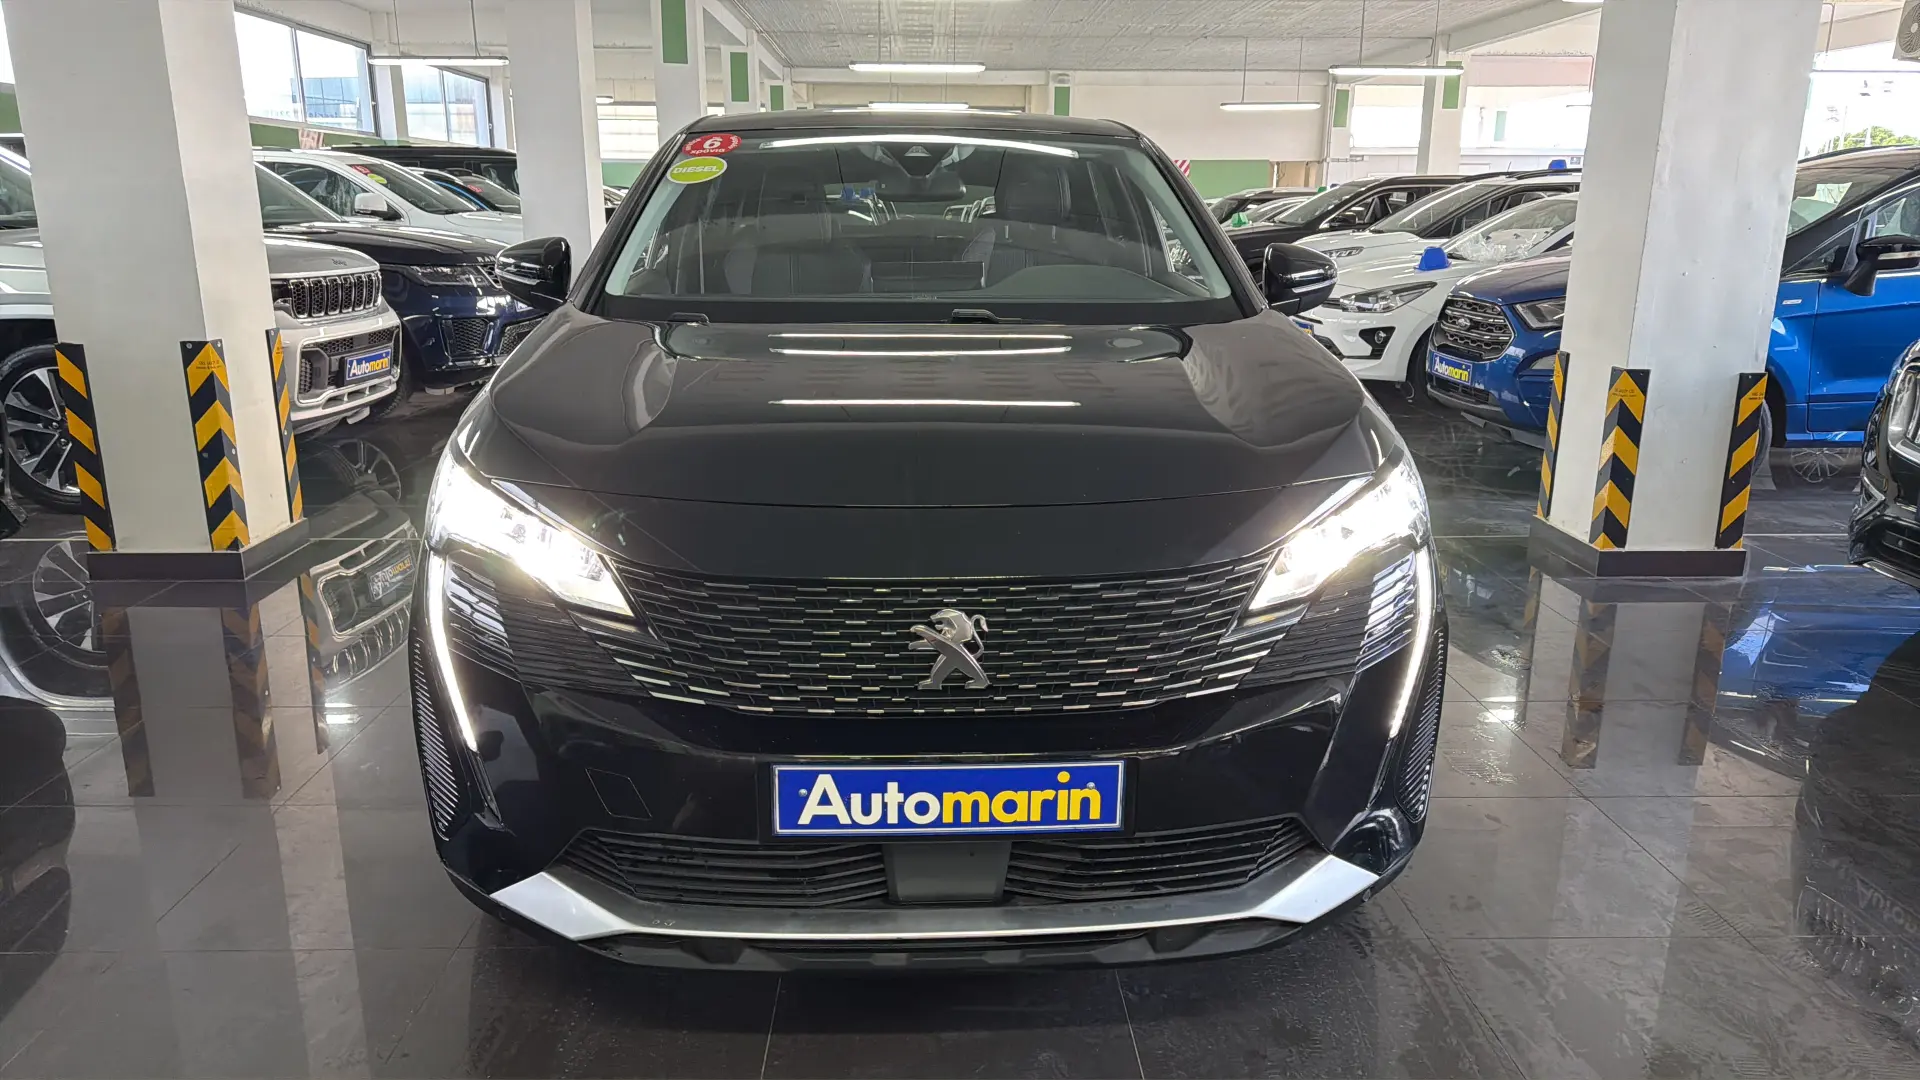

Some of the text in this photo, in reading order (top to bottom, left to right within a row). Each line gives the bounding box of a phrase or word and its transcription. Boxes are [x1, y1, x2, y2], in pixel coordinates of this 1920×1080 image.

[703, 138, 723, 149] 6
[672, 165, 720, 174] DIESEL
[349, 357, 390, 377] Automarin
[797, 771, 1101, 825] Automarin
